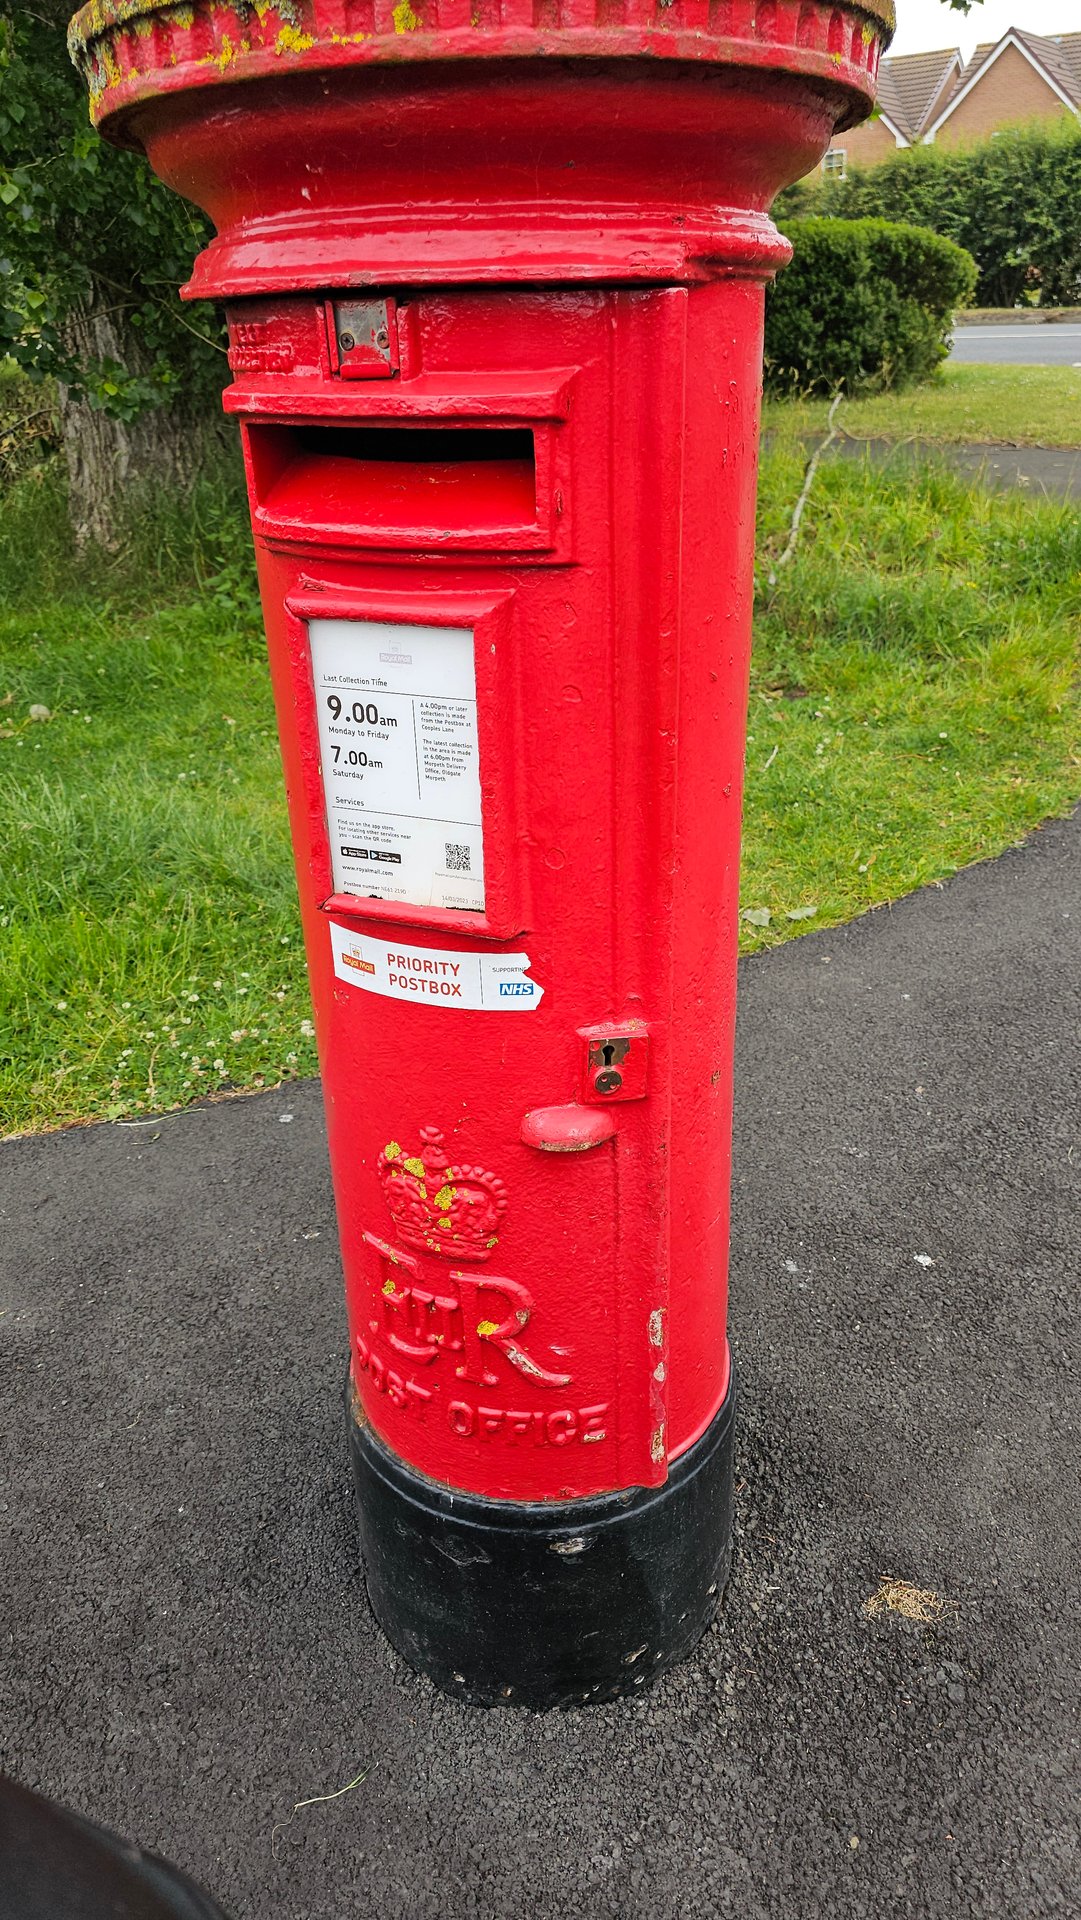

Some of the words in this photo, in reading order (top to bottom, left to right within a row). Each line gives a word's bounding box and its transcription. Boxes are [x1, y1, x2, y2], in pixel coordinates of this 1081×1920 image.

[339, 676, 369, 685] Collection
[371, 678, 387, 687] Time
[327, 695, 398, 727] 9.00am
[421, 710, 444, 718] collection
[444, 719, 464, 727] Postbox
[328, 726, 356, 737] Monday
[367, 730, 390, 740] Friday
[449, 741, 473, 749] collection
[330, 745, 383, 768] 7.00am
[446, 762, 467, 771] Delivery
[332, 769, 364, 780] Saturday
[335, 796, 365, 806] Services
[347, 826, 366, 835] locating
[380, 831, 400, 839] services
[342, 865, 394, 877] www.royalmail.com
[342, 954, 360, 969] Royal
[359, 960, 376, 974] Mail
[387, 953, 461, 977] PRIORITY
[389, 973, 462, 997] POSTBOX
[500, 983, 533, 995] NHS
[449, 1400, 610, 1447] OFFICE
